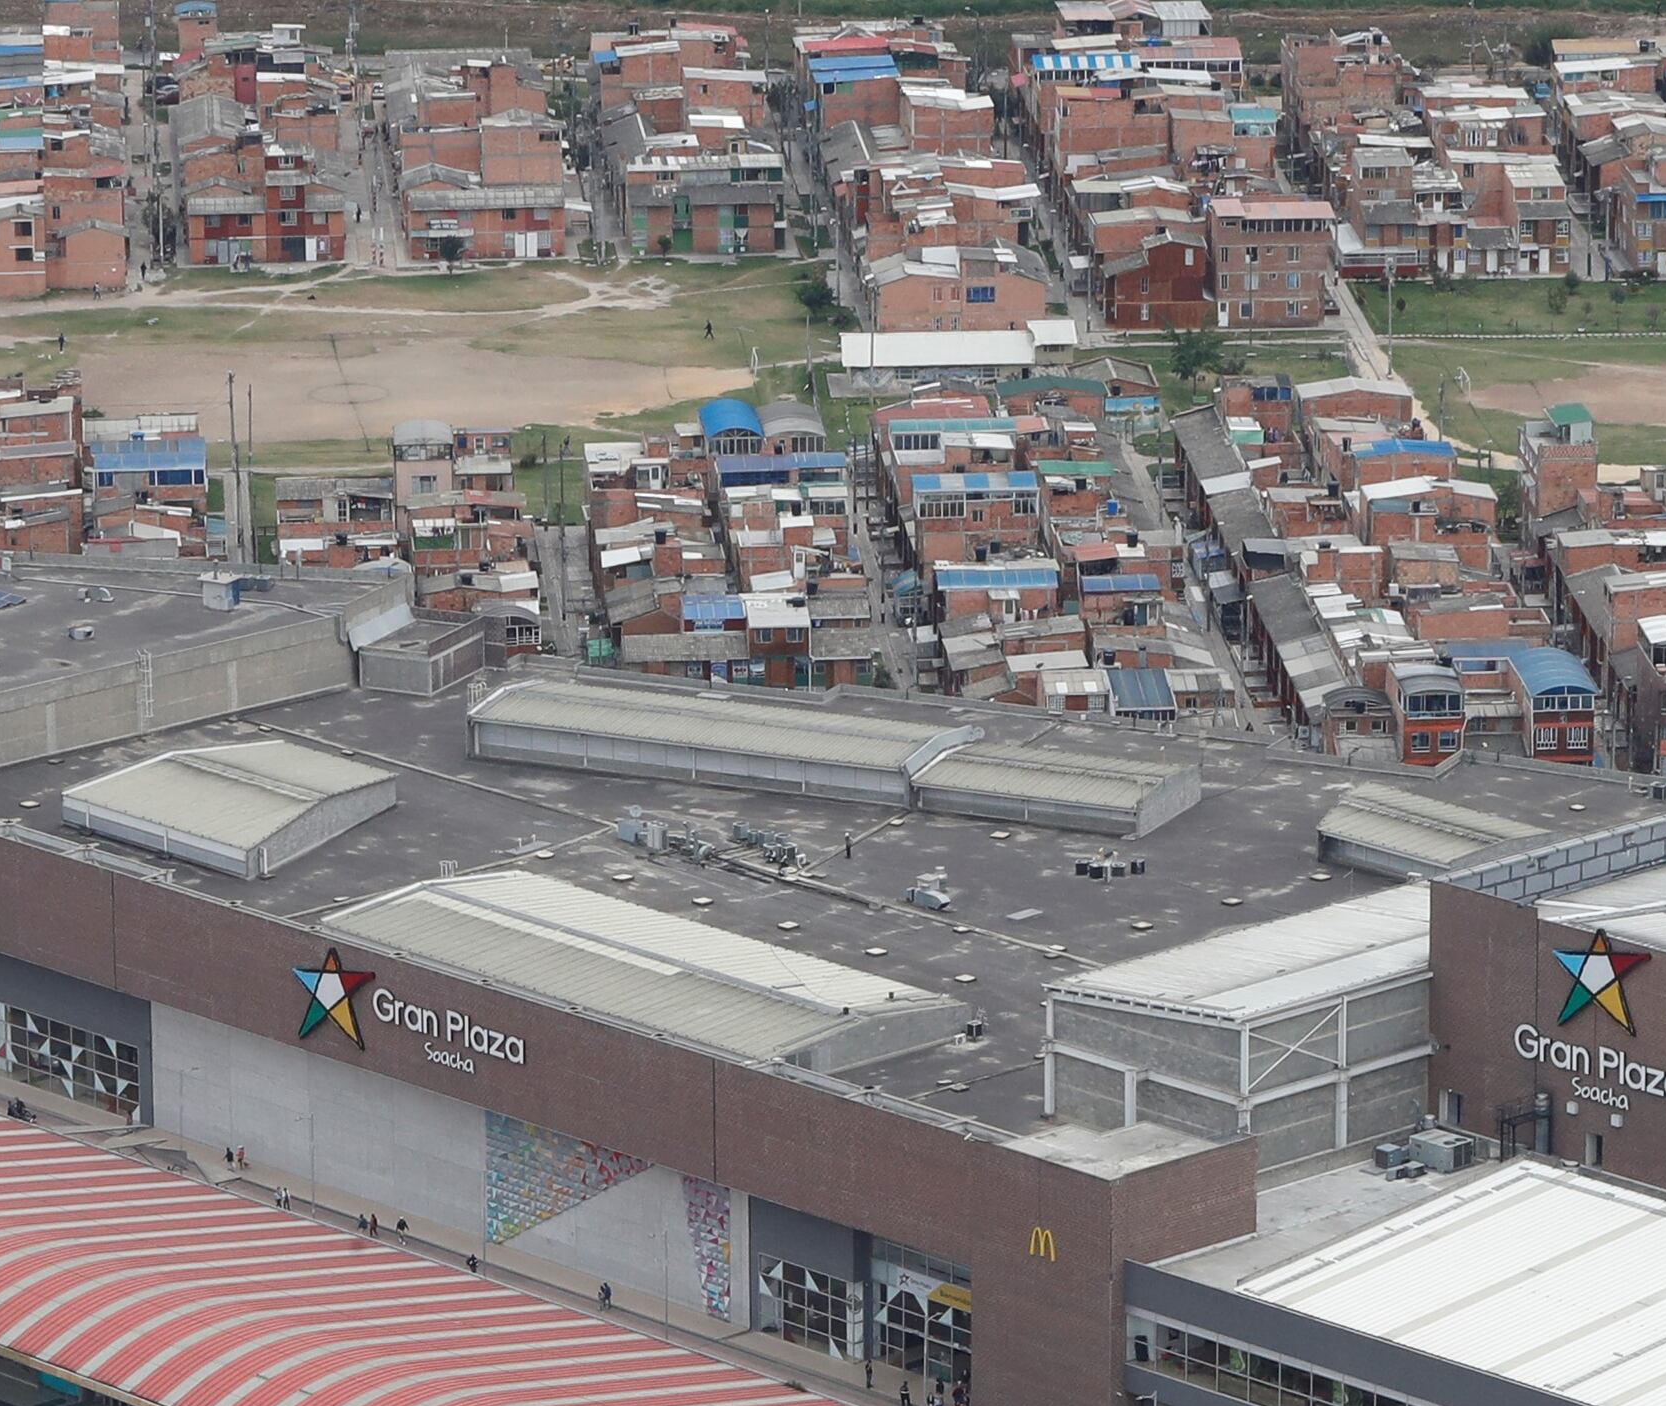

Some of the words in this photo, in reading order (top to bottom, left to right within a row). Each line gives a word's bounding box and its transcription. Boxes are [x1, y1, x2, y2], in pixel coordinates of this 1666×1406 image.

[373, 988, 438, 1038] Gran
[446, 1010, 526, 1064] Plaza
[424, 1042, 475, 1074] Soacha
[1514, 1023, 1590, 1075] Gran
[1571, 1076, 1629, 1111] Soacha
